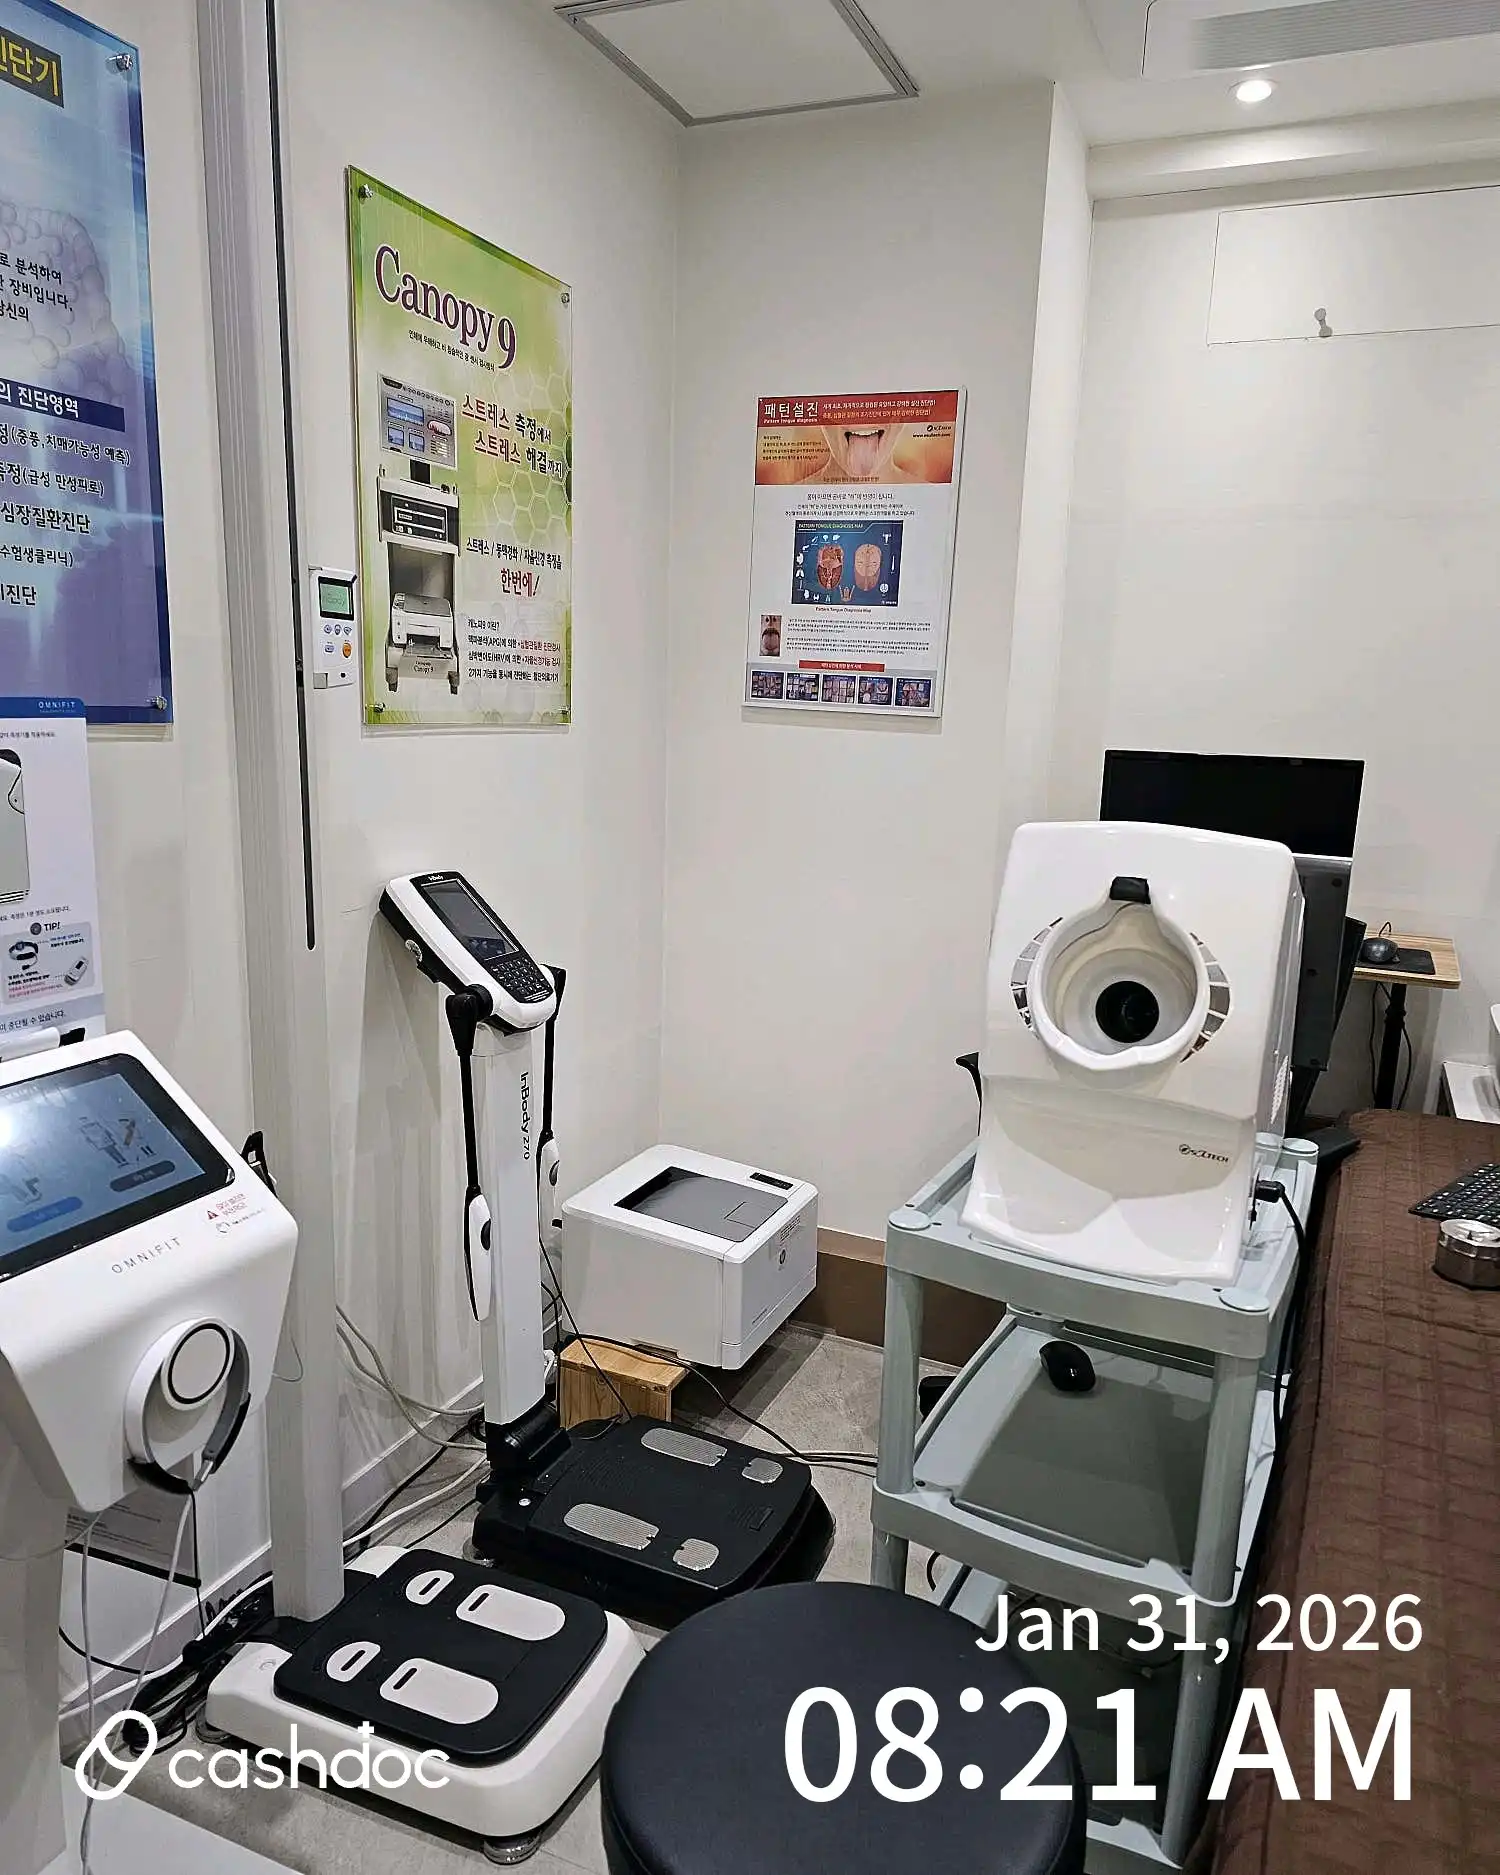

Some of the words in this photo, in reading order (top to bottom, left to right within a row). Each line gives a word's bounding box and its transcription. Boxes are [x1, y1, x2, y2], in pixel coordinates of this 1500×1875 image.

[15, 257, 62, 285] 분석하여
[9, 278, 73, 312] 장비입니다.
[376, 245, 495, 351] Canopy
[498, 318, 516, 369] 9
[17, 386, 79, 418] 진단영역
[764, 402, 819, 418] 패턴설진
[462, 394, 510, 431] 스트레스
[514, 412, 552, 445] 측정에서
[104, 446, 131, 466] 예측)
[475, 431, 521, 464] 스트레스
[525, 446, 563, 478] 해결까지
[55, 473, 104, 498] 만성피로)
[1, 502, 91, 534] 심장질환진단
[0, 544, 73, 568] 수험생클리닉)
[466, 537, 490, 555] 스트레스
[496, 543, 518, 562] 동맥경화
[524, 549, 545, 567] 자율신경
[500, 567, 540, 598] 한번에!
[520, 1071, 531, 1133] InBody
[522, 1135, 531, 1160] 270
[111, 1236, 180, 1274] OMNIFIT
